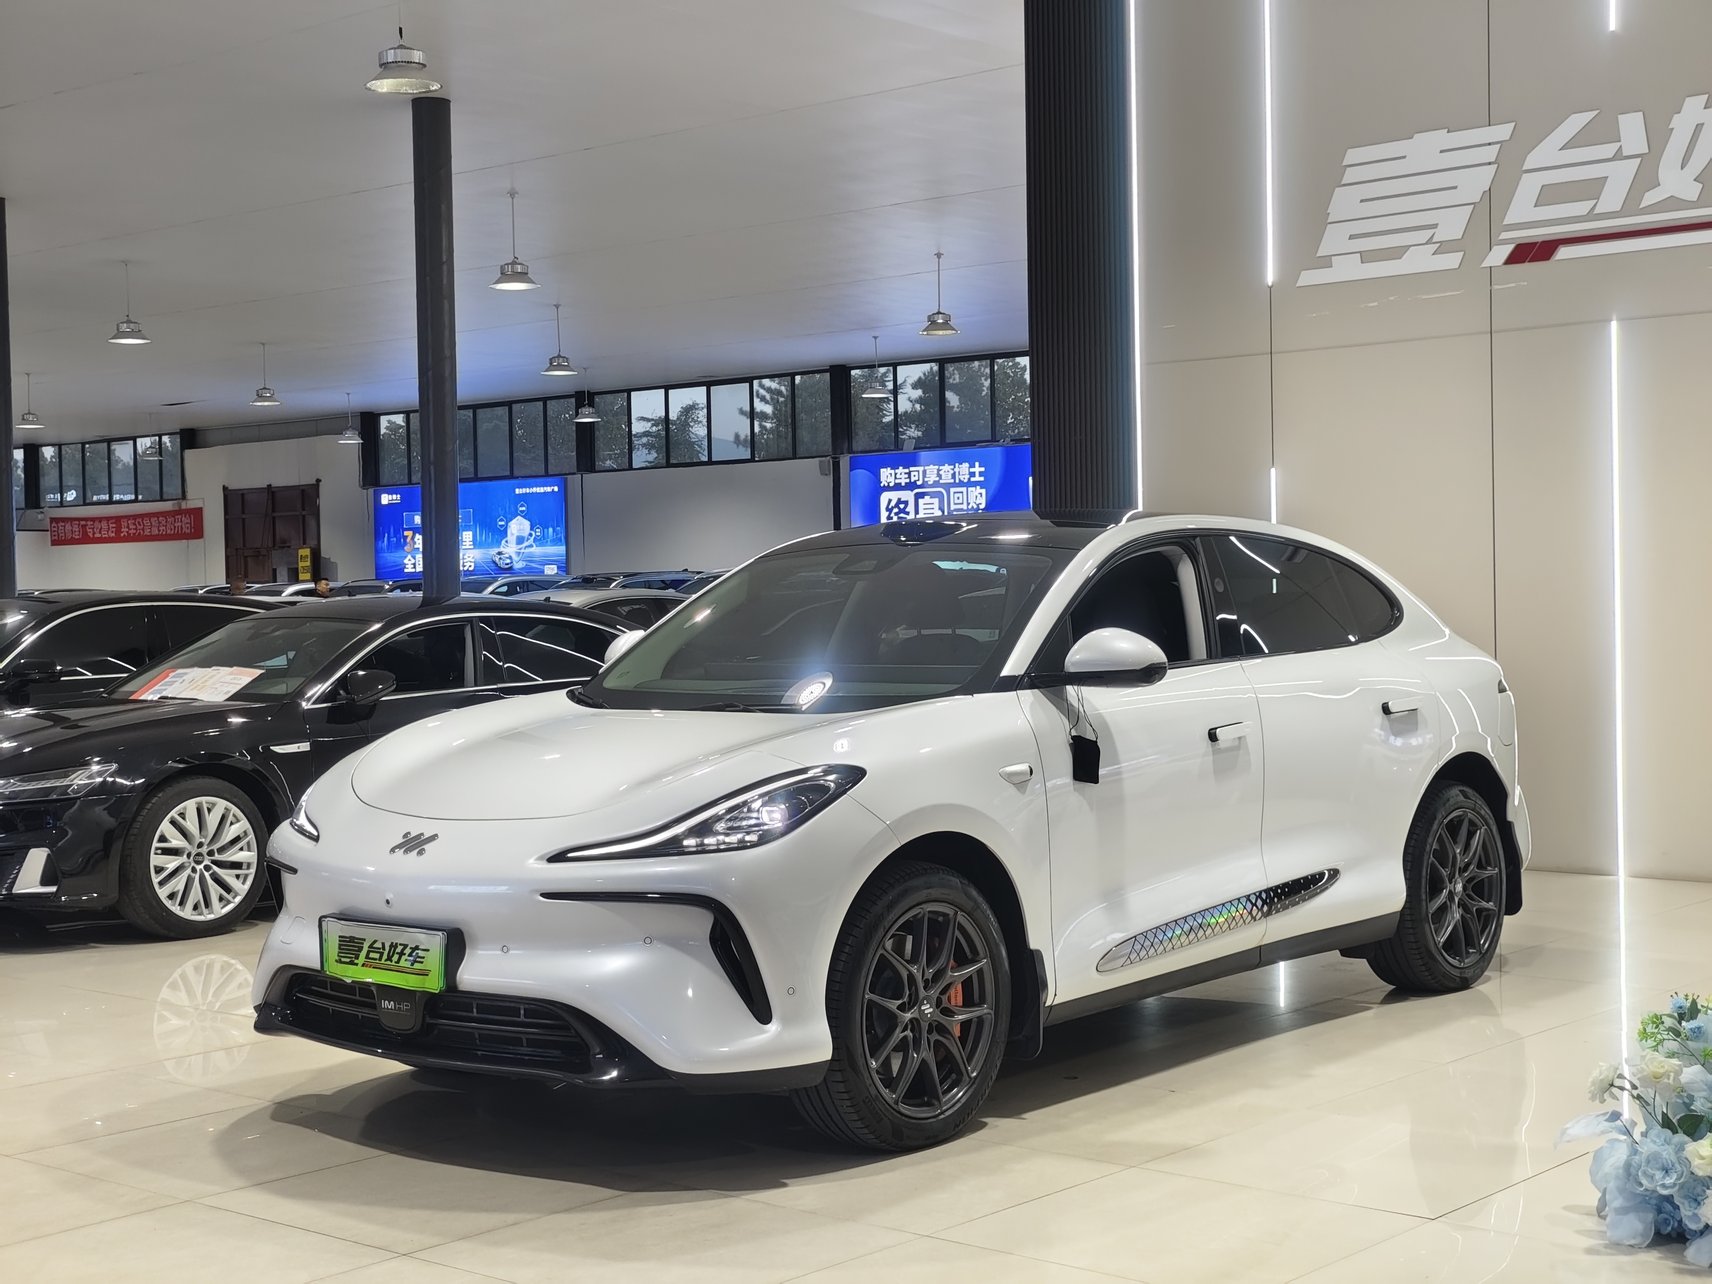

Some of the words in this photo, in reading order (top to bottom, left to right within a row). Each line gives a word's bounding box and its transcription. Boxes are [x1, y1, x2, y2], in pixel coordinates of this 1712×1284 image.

[880, 462, 985, 487] 购车可享查博士
[335, 935, 430, 966] 壹台好车
